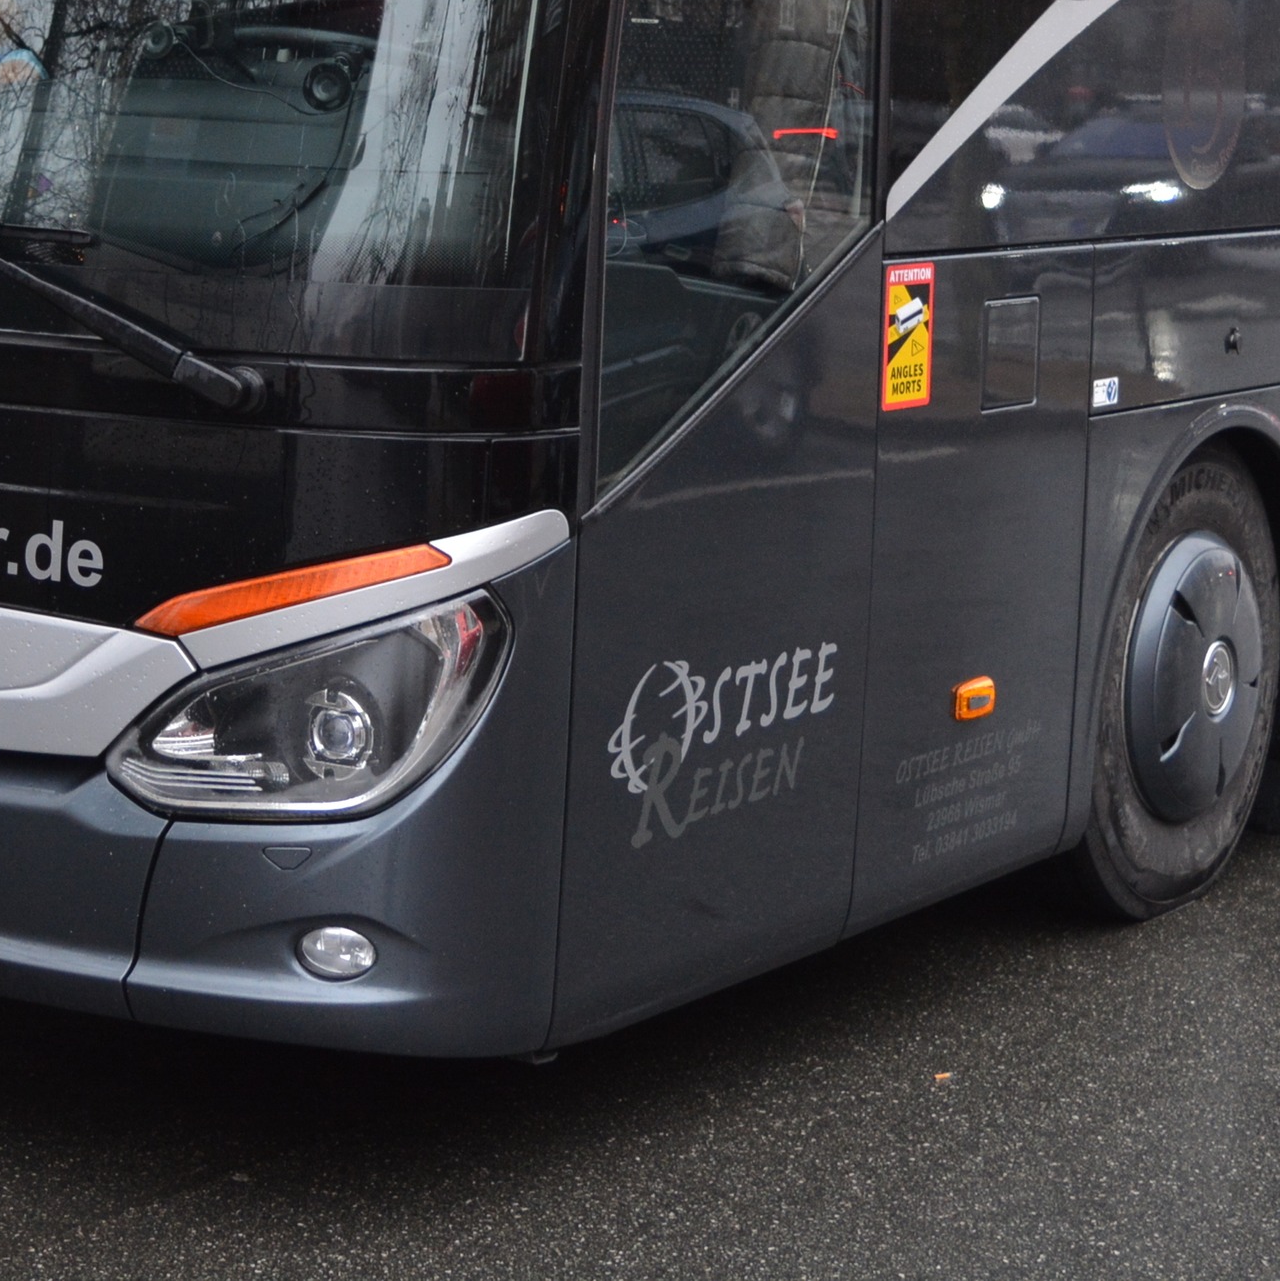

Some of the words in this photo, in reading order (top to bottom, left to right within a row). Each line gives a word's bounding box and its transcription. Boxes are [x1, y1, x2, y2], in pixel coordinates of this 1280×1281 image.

[889, 267, 931, 282] ATTENTION
[890, 364, 924, 380] ANGLES
[891, 379, 922, 395] MORTS
[608, 642, 838, 793] OSTSEE
[896, 746, 950, 784] OSTSEE
[953, 729, 1005, 766] REISEN
[631, 732, 804, 849] REISEN
[964, 790, 1008, 818] Wismar
